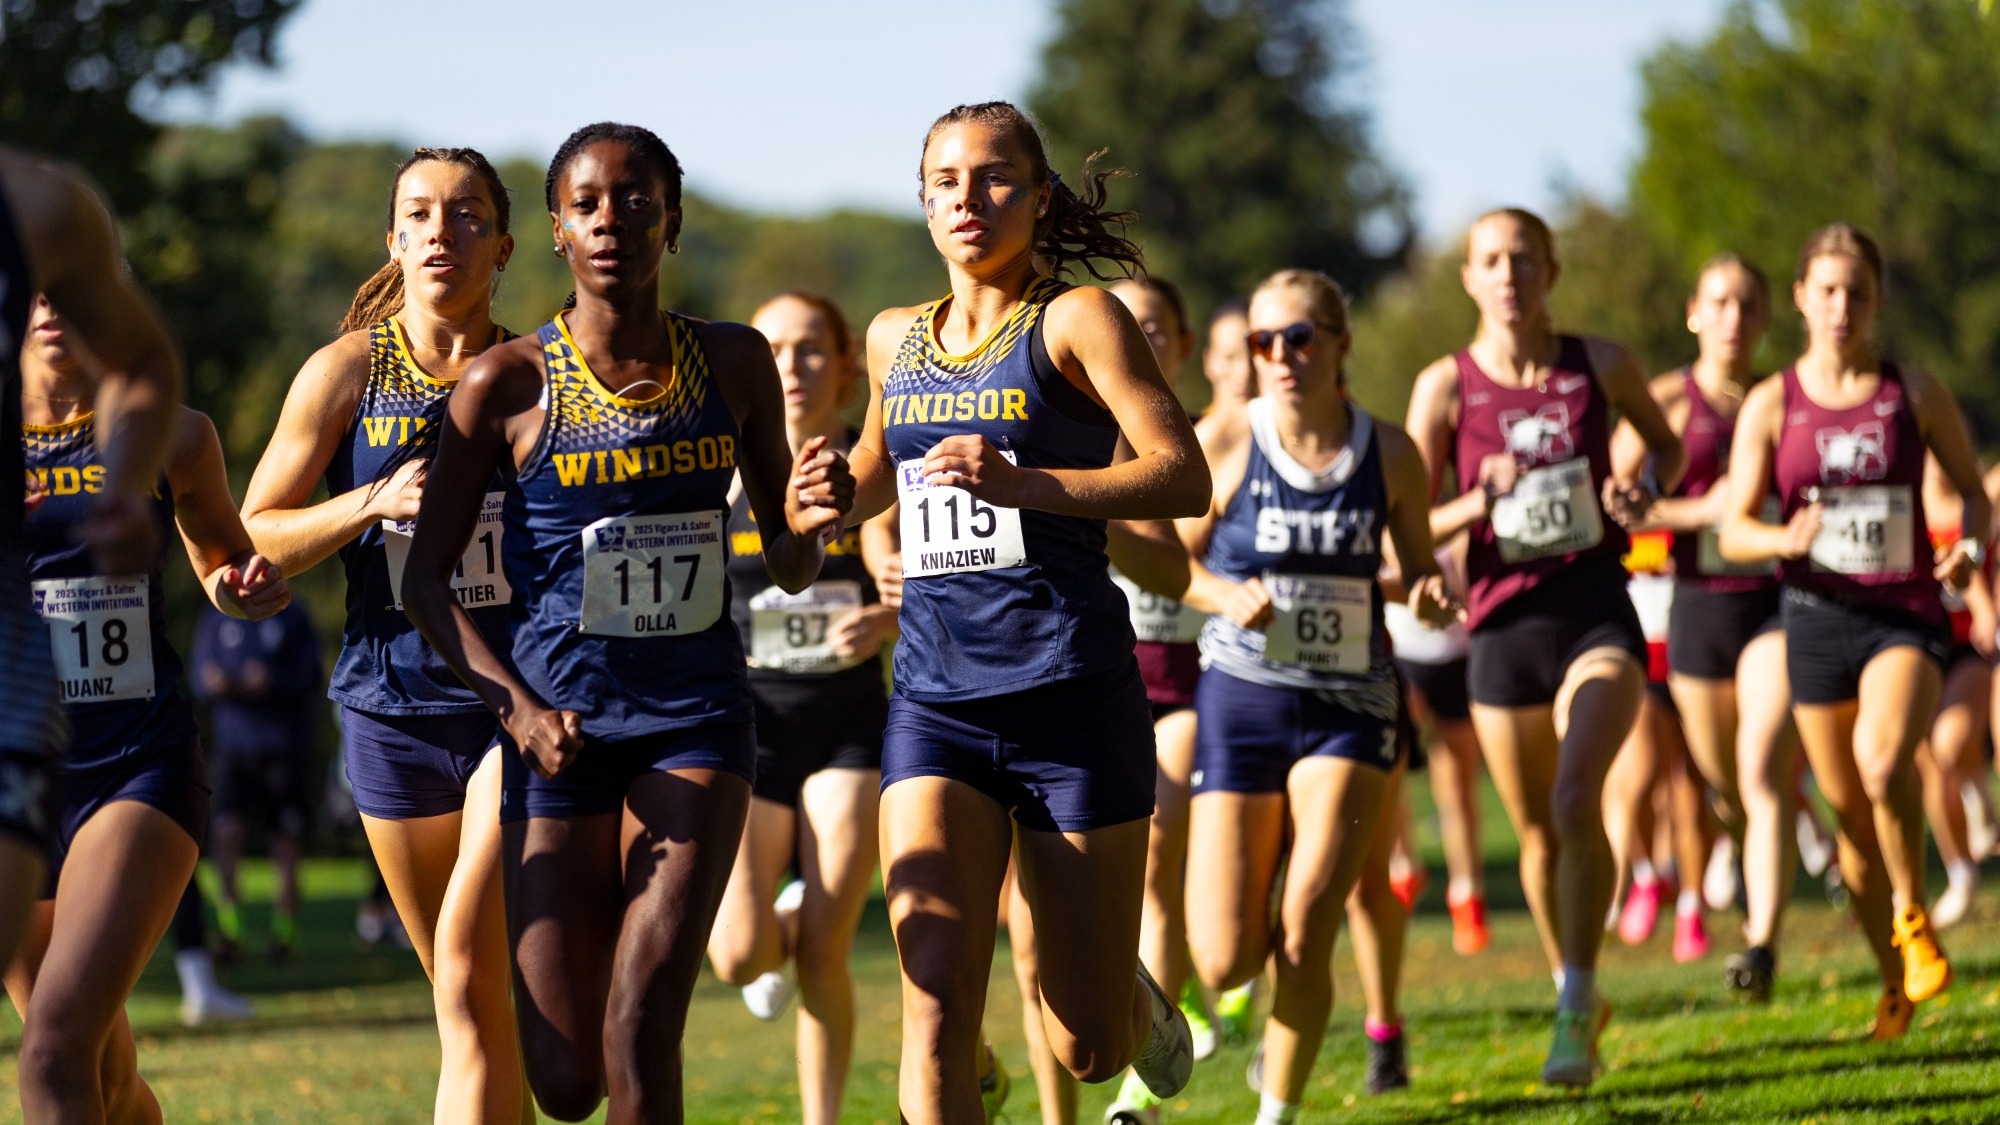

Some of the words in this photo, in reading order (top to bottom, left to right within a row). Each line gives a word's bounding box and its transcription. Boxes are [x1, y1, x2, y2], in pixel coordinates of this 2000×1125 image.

[883, 388, 1028, 430] WINDSOR
[552, 435, 735, 487] WINDSOR
[634, 525, 652, 535] 2025
[655, 523, 681, 535] Vigars
[681, 522, 689, 531] &
[690, 521, 711, 531] Salter
[918, 494, 996, 542] 115
[1255, 507, 1375, 555] STFX
[1527, 502, 1570, 533] 50
[626, 535, 665, 550] WESTERN
[667, 532, 718, 547] INVITATIONAL
[921, 548, 996, 570] KNIAZIEW
[55, 588, 76, 599] 2025
[614, 554, 701, 606] 117
[47, 600, 90, 614] WESTERN
[92, 597, 144, 611] INVITATIONAL
[634, 613, 677, 632] OLLA
[785, 614, 828, 647] 87
[1296, 609, 1342, 644] 63
